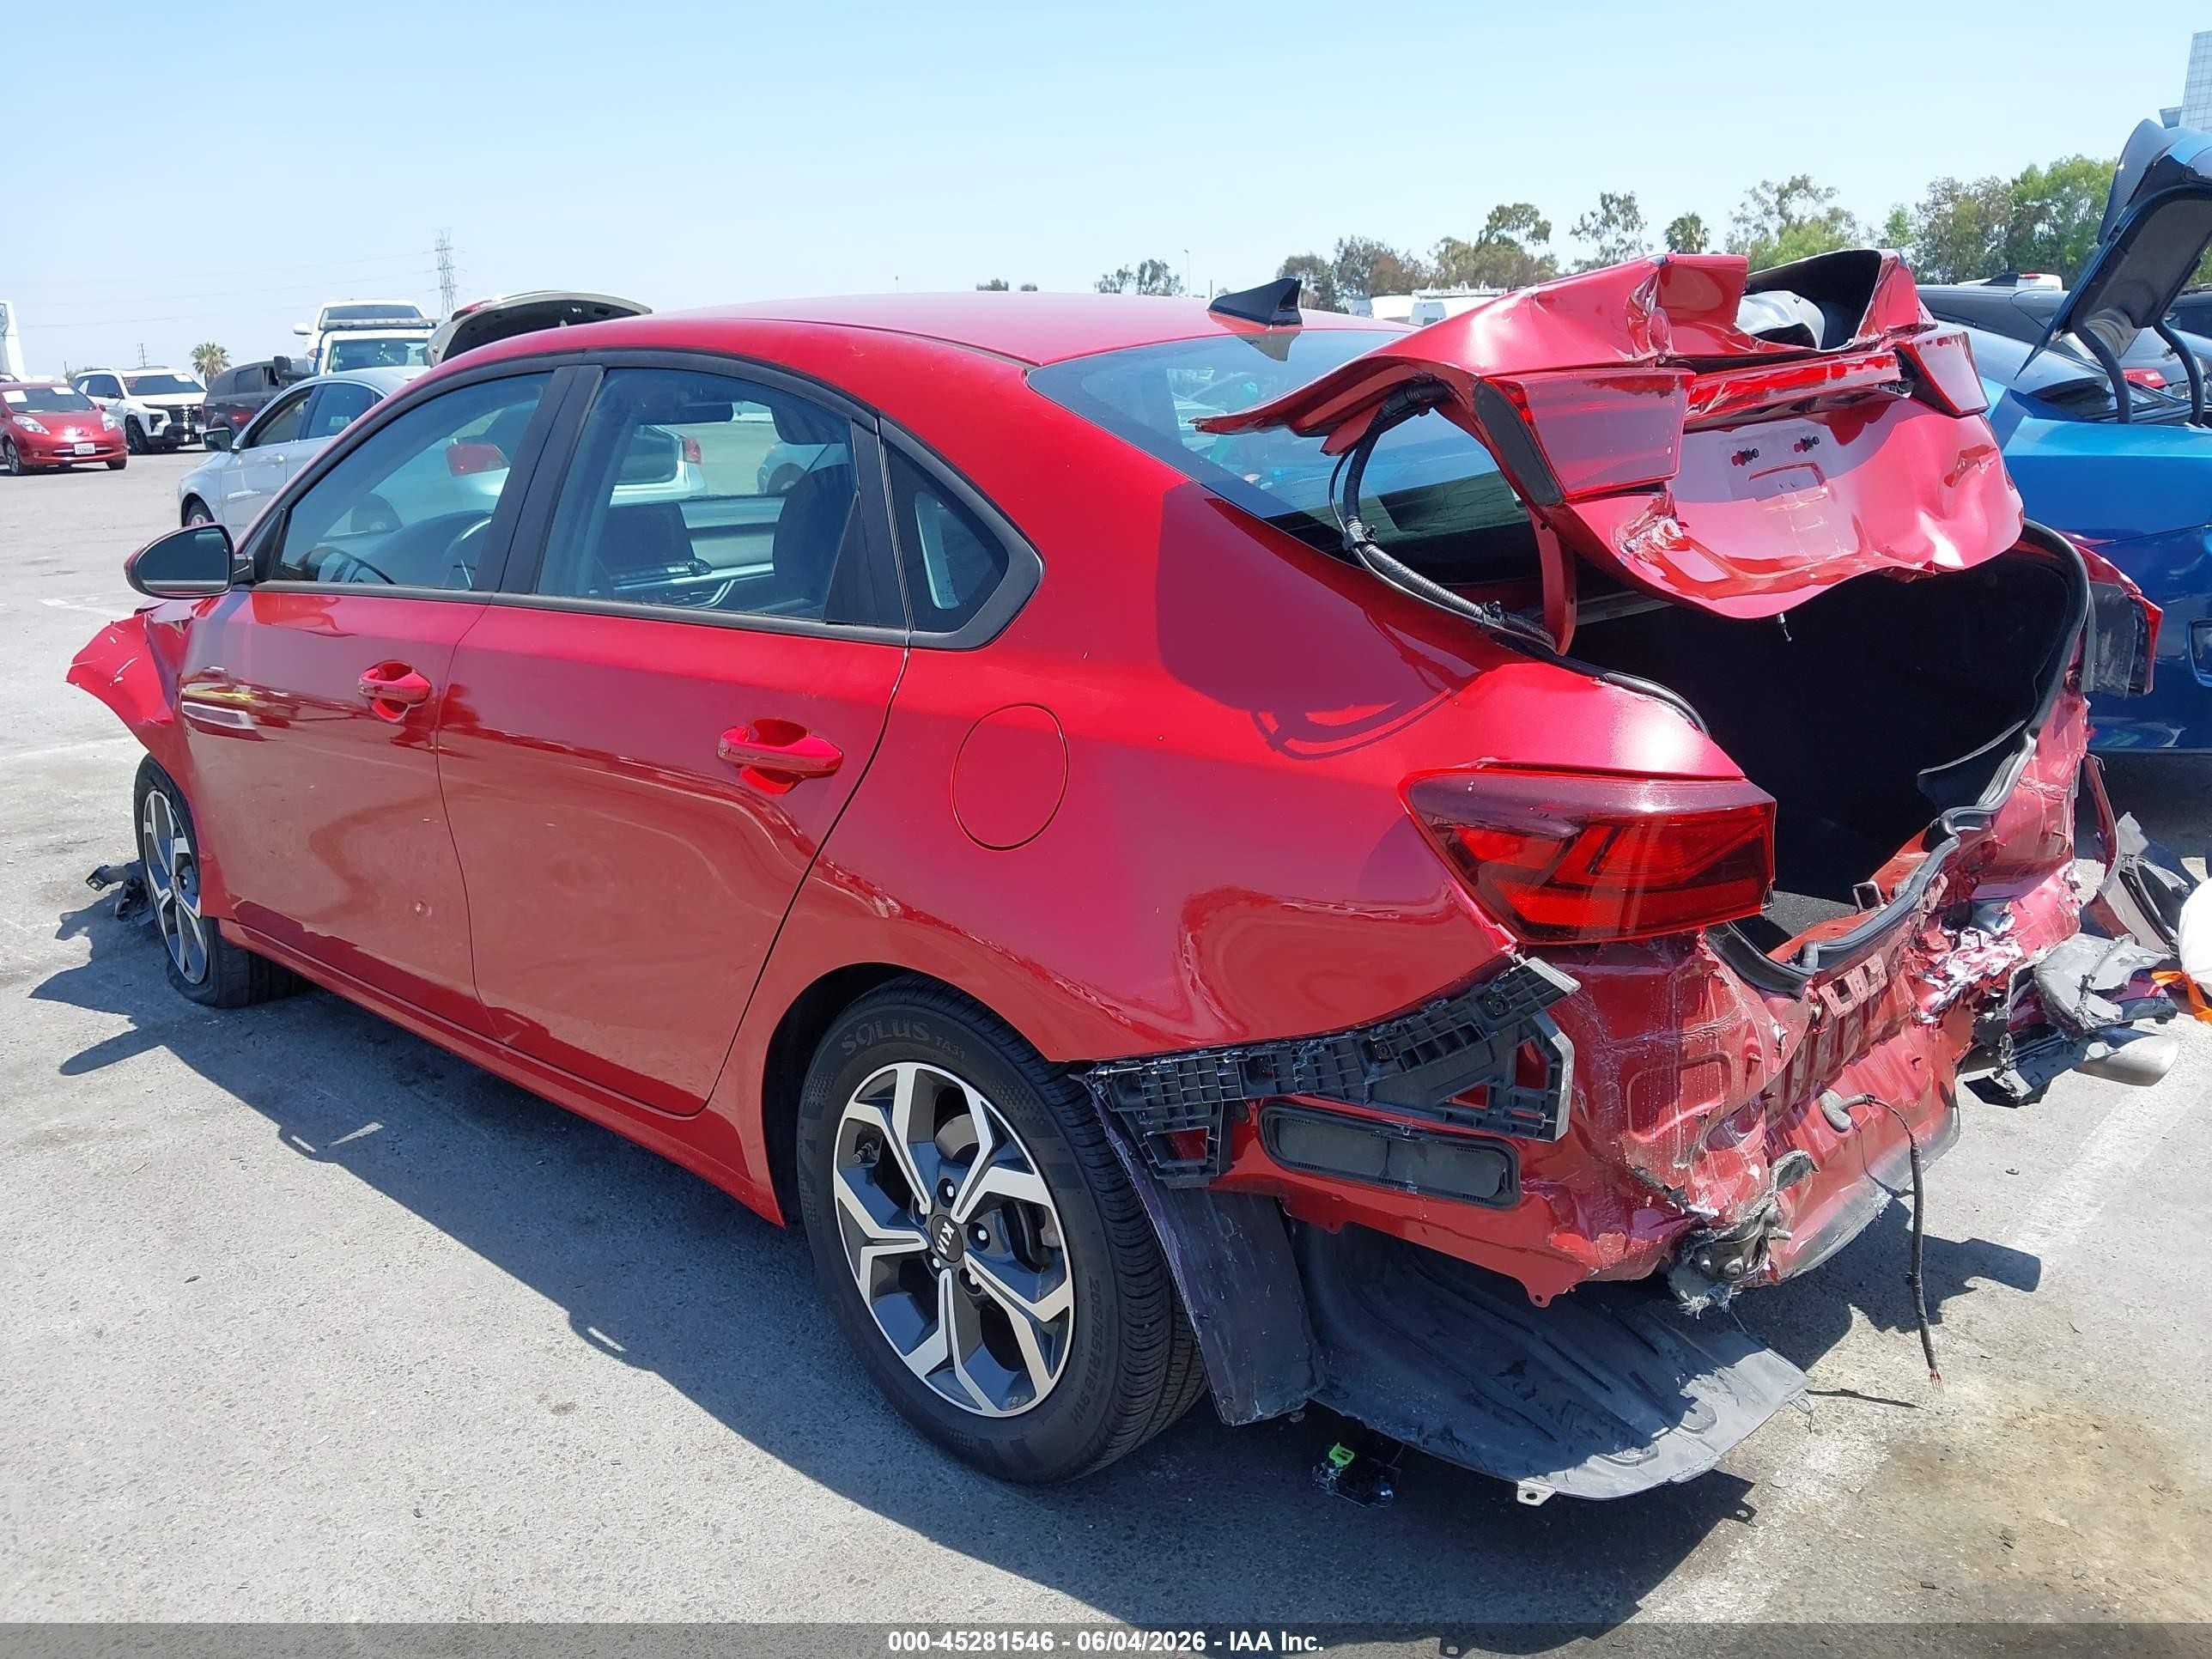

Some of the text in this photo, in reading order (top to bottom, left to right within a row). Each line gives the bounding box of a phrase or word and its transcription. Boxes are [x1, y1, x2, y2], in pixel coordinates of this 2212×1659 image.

[842, 1018, 967, 1060] SOLUS TA31
[937, 1221, 955, 1255] KIA
